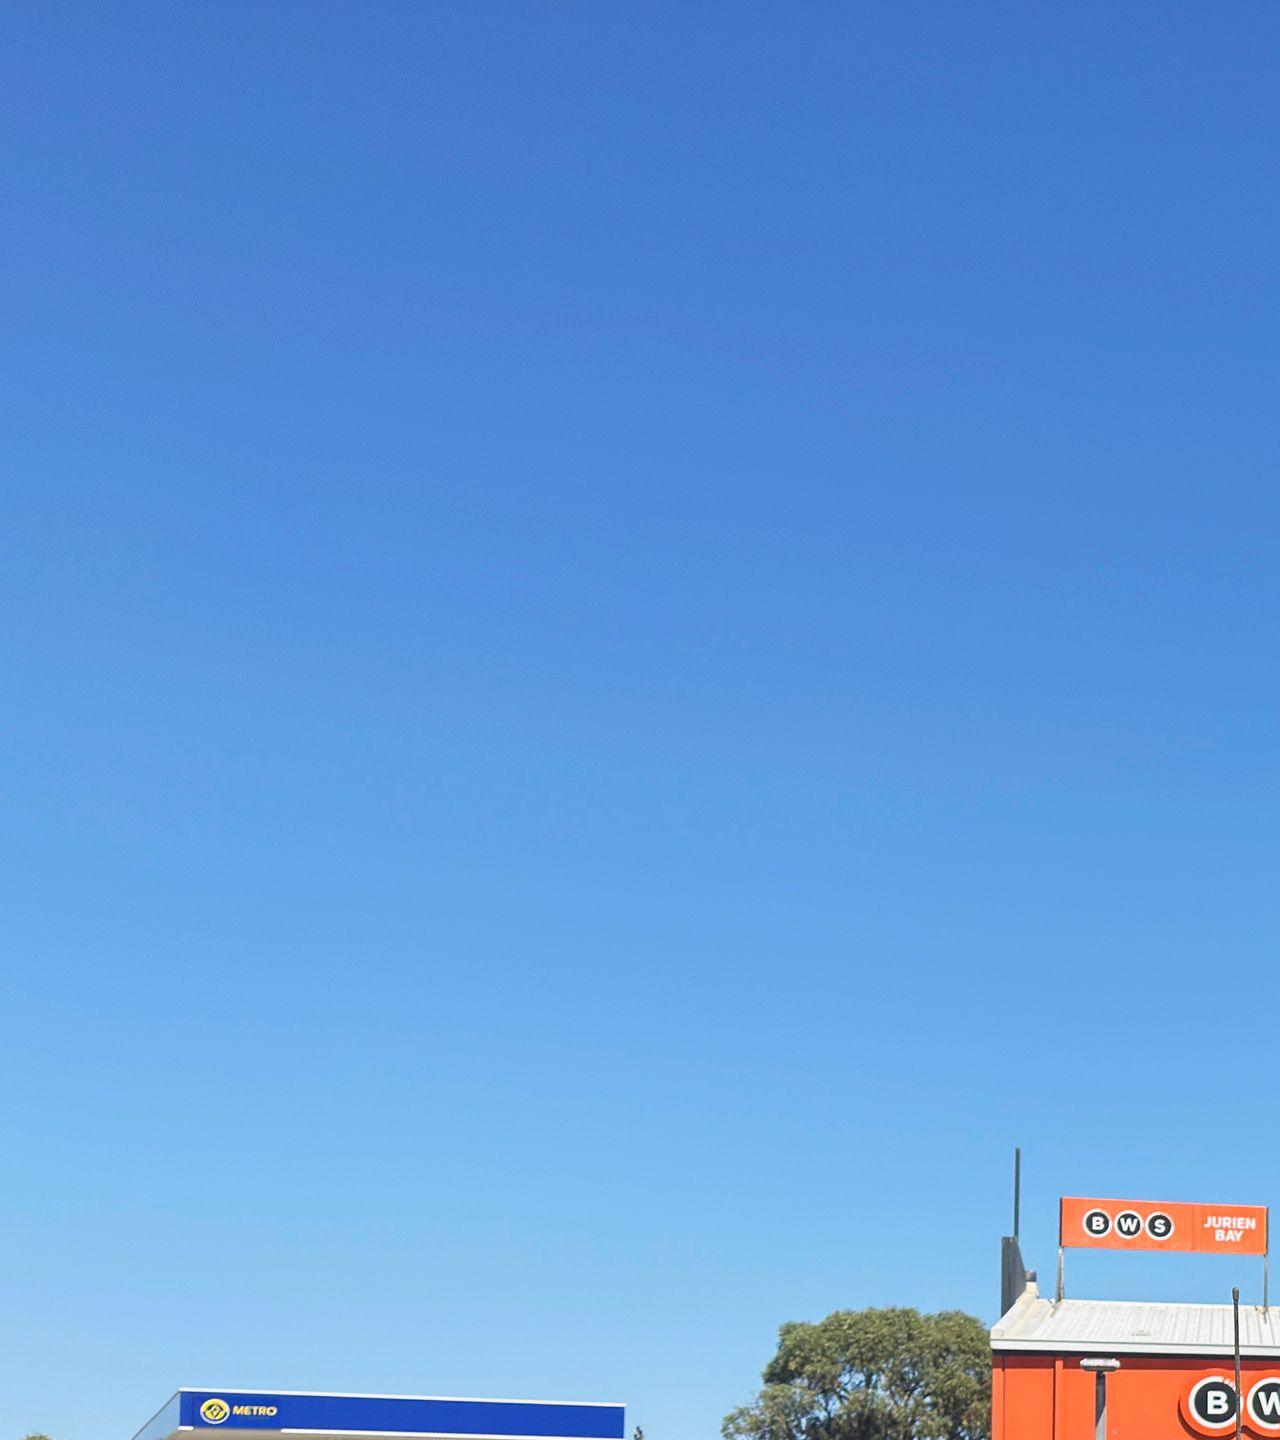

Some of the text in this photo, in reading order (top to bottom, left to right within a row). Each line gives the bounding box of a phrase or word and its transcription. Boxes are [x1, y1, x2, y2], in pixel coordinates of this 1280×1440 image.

[1203, 1216, 1256, 1230] JURIEN
[1215, 1229, 1243, 1242] BAY
[232, 1405, 278, 1416] METRO
